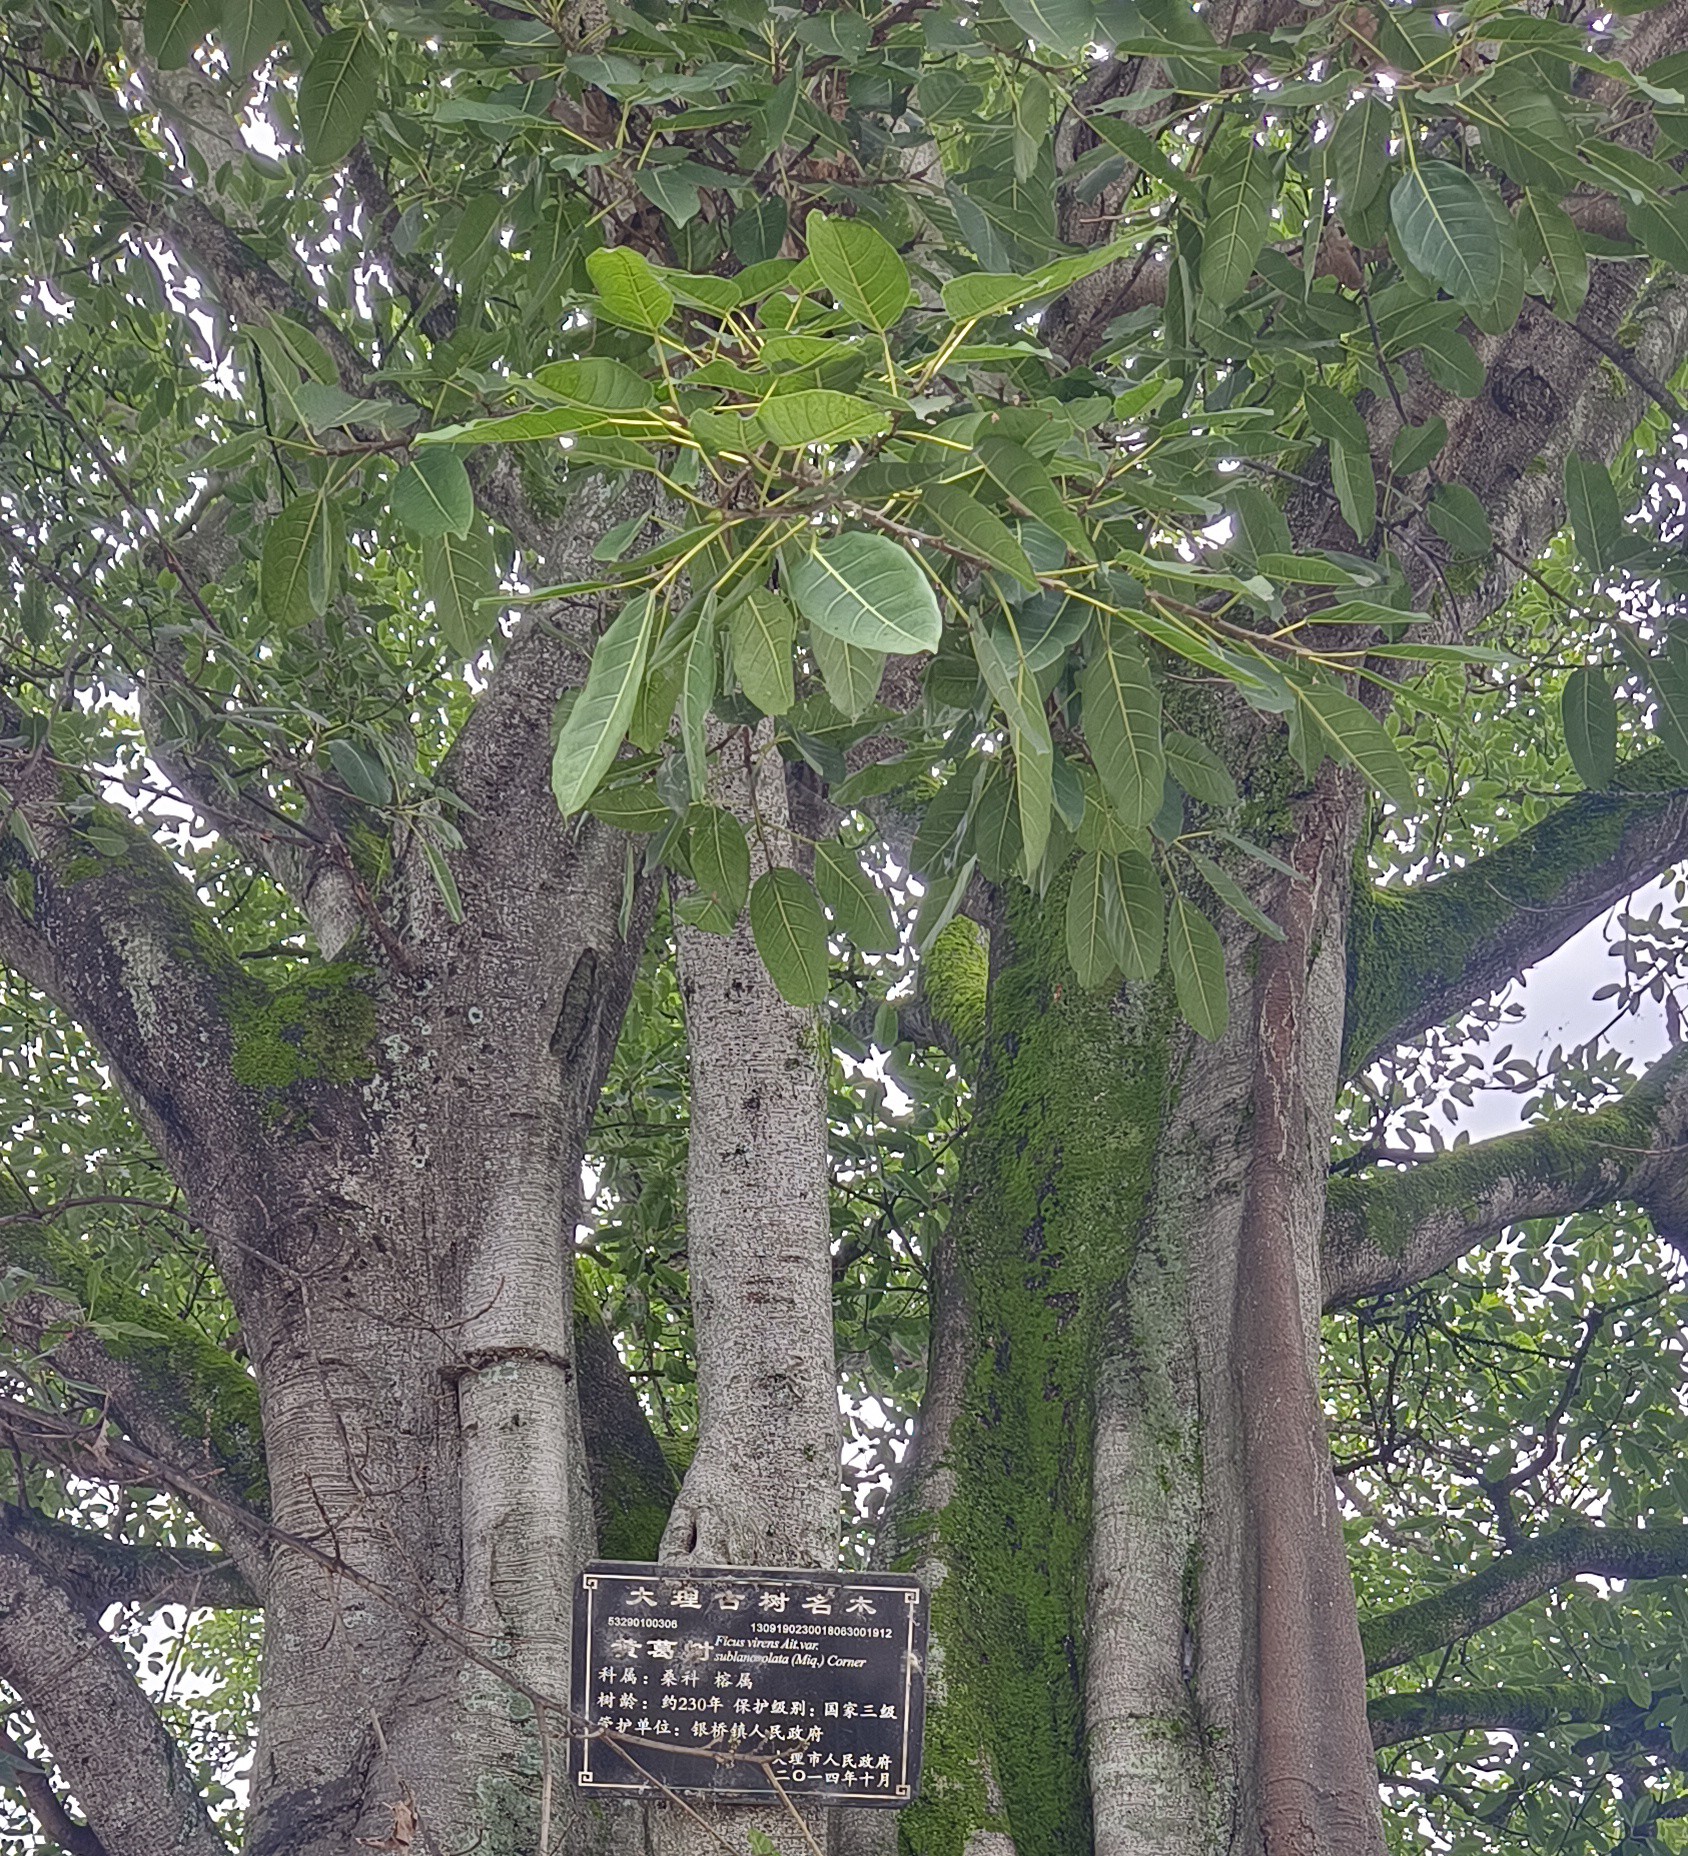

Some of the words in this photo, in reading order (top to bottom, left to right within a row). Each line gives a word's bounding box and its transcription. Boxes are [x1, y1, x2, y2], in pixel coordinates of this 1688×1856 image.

[625, 1586, 877, 1615] 大理古树名木
[607, 1616, 678, 1629] 53290100306
[610, 1638, 715, 1661] 黄葛树
[714, 1634, 745, 1648] Ficus
[747, 1636, 780, 1649] virens
[791, 1653, 825, 1669] (Miq.)
[826, 1654, 867, 1668] Corner
[660, 1669, 700, 1688] 桑科
[714, 1671, 753, 1690] 榕属
[661, 1694, 724, 1714] 约230年
[824, 1701, 898, 1720] 国家三级
[690, 1720, 824, 1743] 银桥镇人民政府
